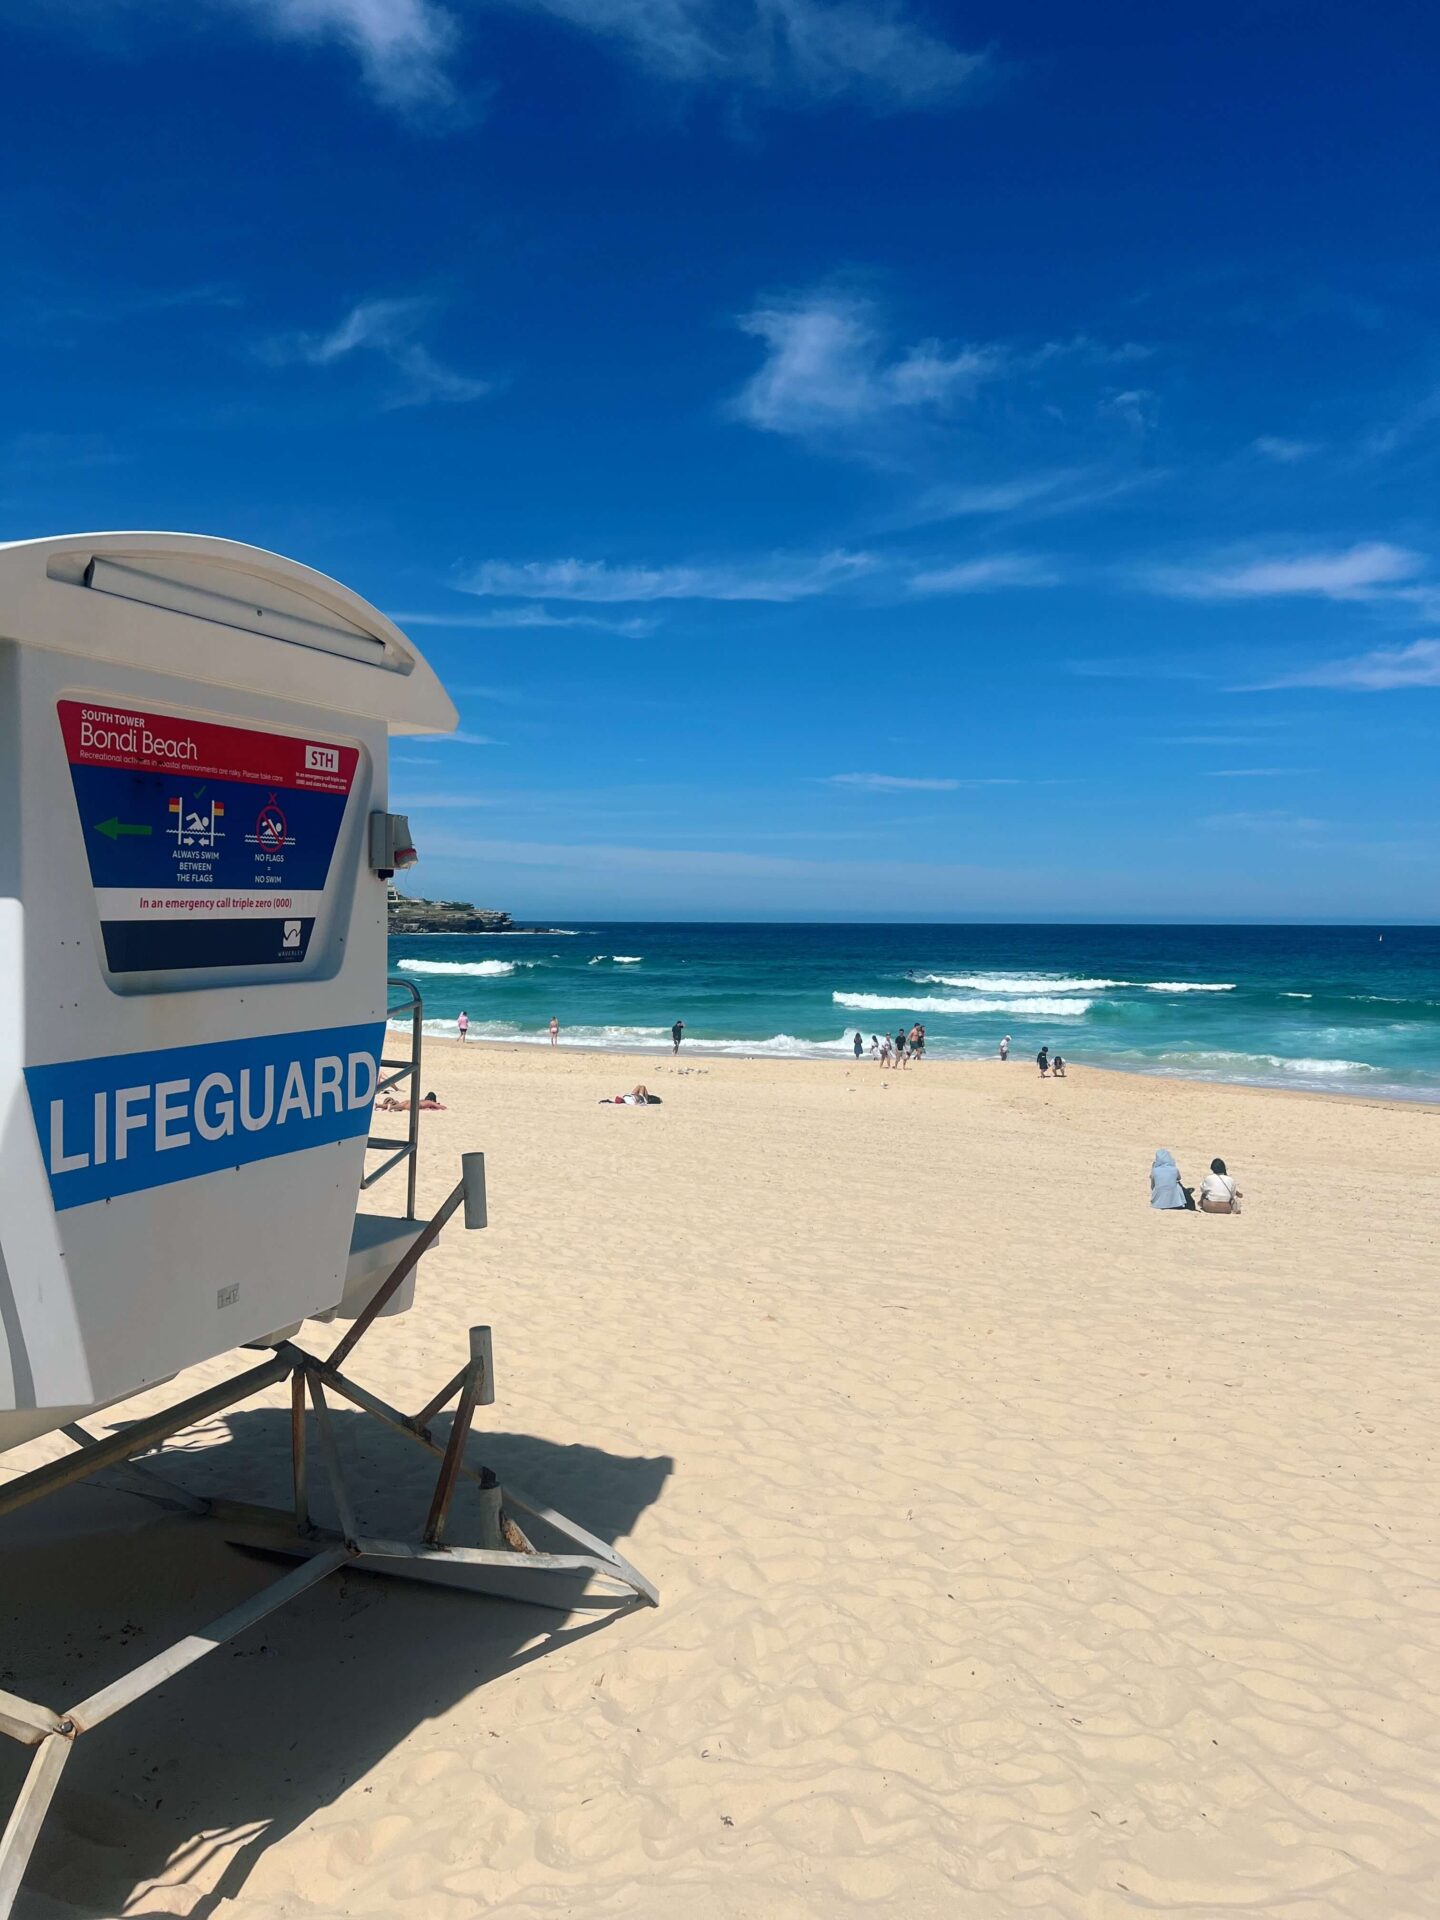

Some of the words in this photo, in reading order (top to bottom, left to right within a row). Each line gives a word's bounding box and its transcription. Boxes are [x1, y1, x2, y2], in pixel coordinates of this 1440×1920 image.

[81, 709, 113, 723] SOUTH
[114, 714, 145, 728] TOWER
[81, 722, 137, 752] Bondi
[142, 731, 198, 760] Beach
[80, 750, 122, 762] Recreational
[158, 762, 180, 770] oastal
[311, 751, 334, 768] STH
[172, 850, 200, 859] ALWAYS
[201, 851, 220, 860] SWIM
[255, 853, 265, 862] NO
[265, 854, 285, 863] FLAGS
[179, 862, 212, 871] BETWEEN
[176, 873, 190, 882] THE
[191, 874, 213, 882] FLAGS
[255, 875, 265, 884] NO
[265, 875, 282, 884] SWIM
[140, 897, 149, 908] In
[151, 899, 163, 908] an
[165, 899, 214, 911] emergency
[216, 897, 231, 909] call
[232, 897, 254, 911] triple
[255, 900, 272, 908] zero
[273, 897, 292, 909] (000)
[50, 1051, 377, 1175] LIFEGUARD
